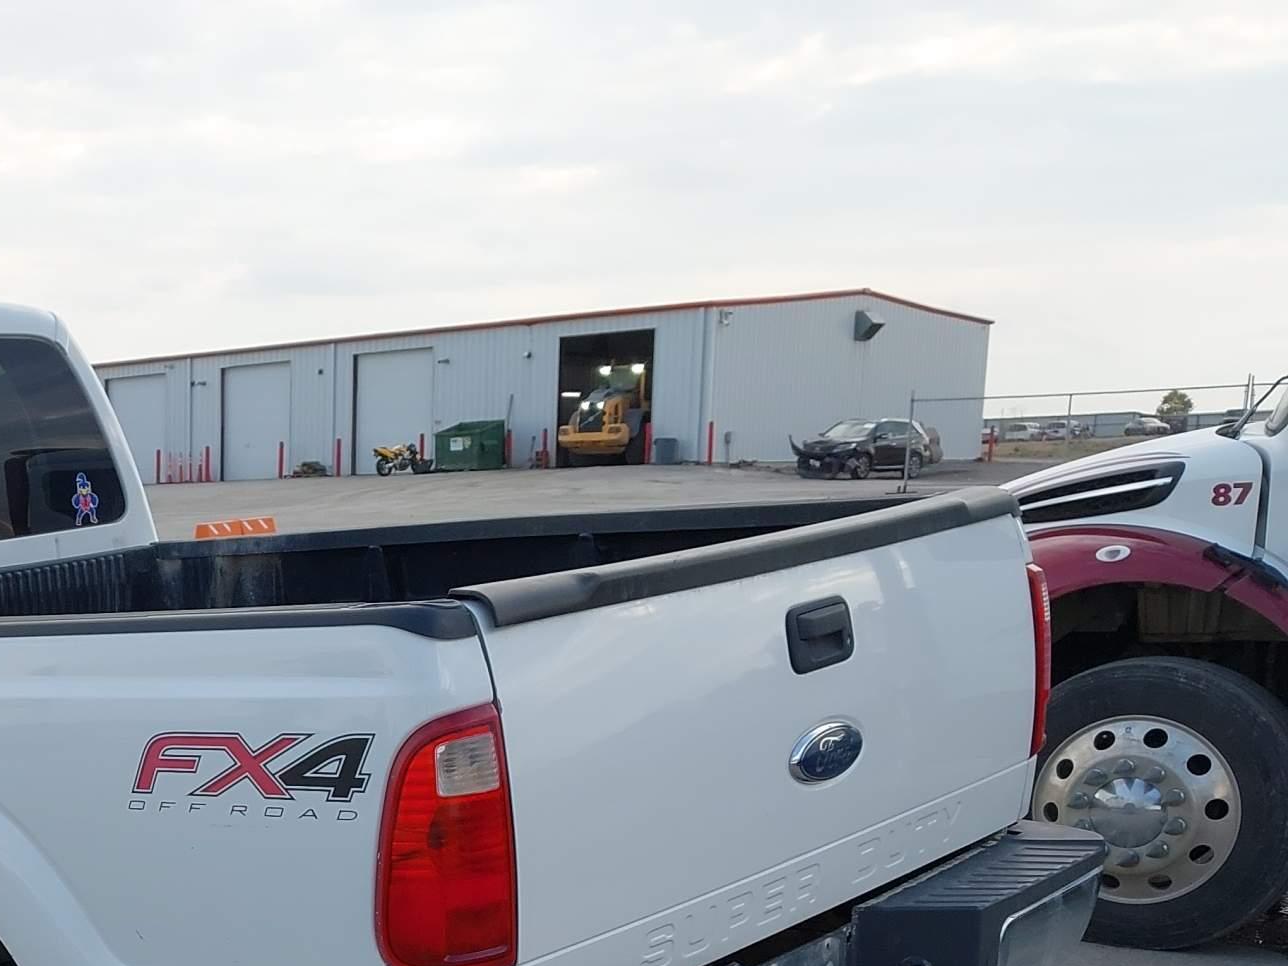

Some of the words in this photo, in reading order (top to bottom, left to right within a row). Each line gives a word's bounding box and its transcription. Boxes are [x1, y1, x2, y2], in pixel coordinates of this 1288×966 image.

[1211, 481, 1253, 507] 87
[131, 731, 376, 803] FX4
[128, 799, 207, 814] OFF
[230, 804, 359, 821] ROAD
